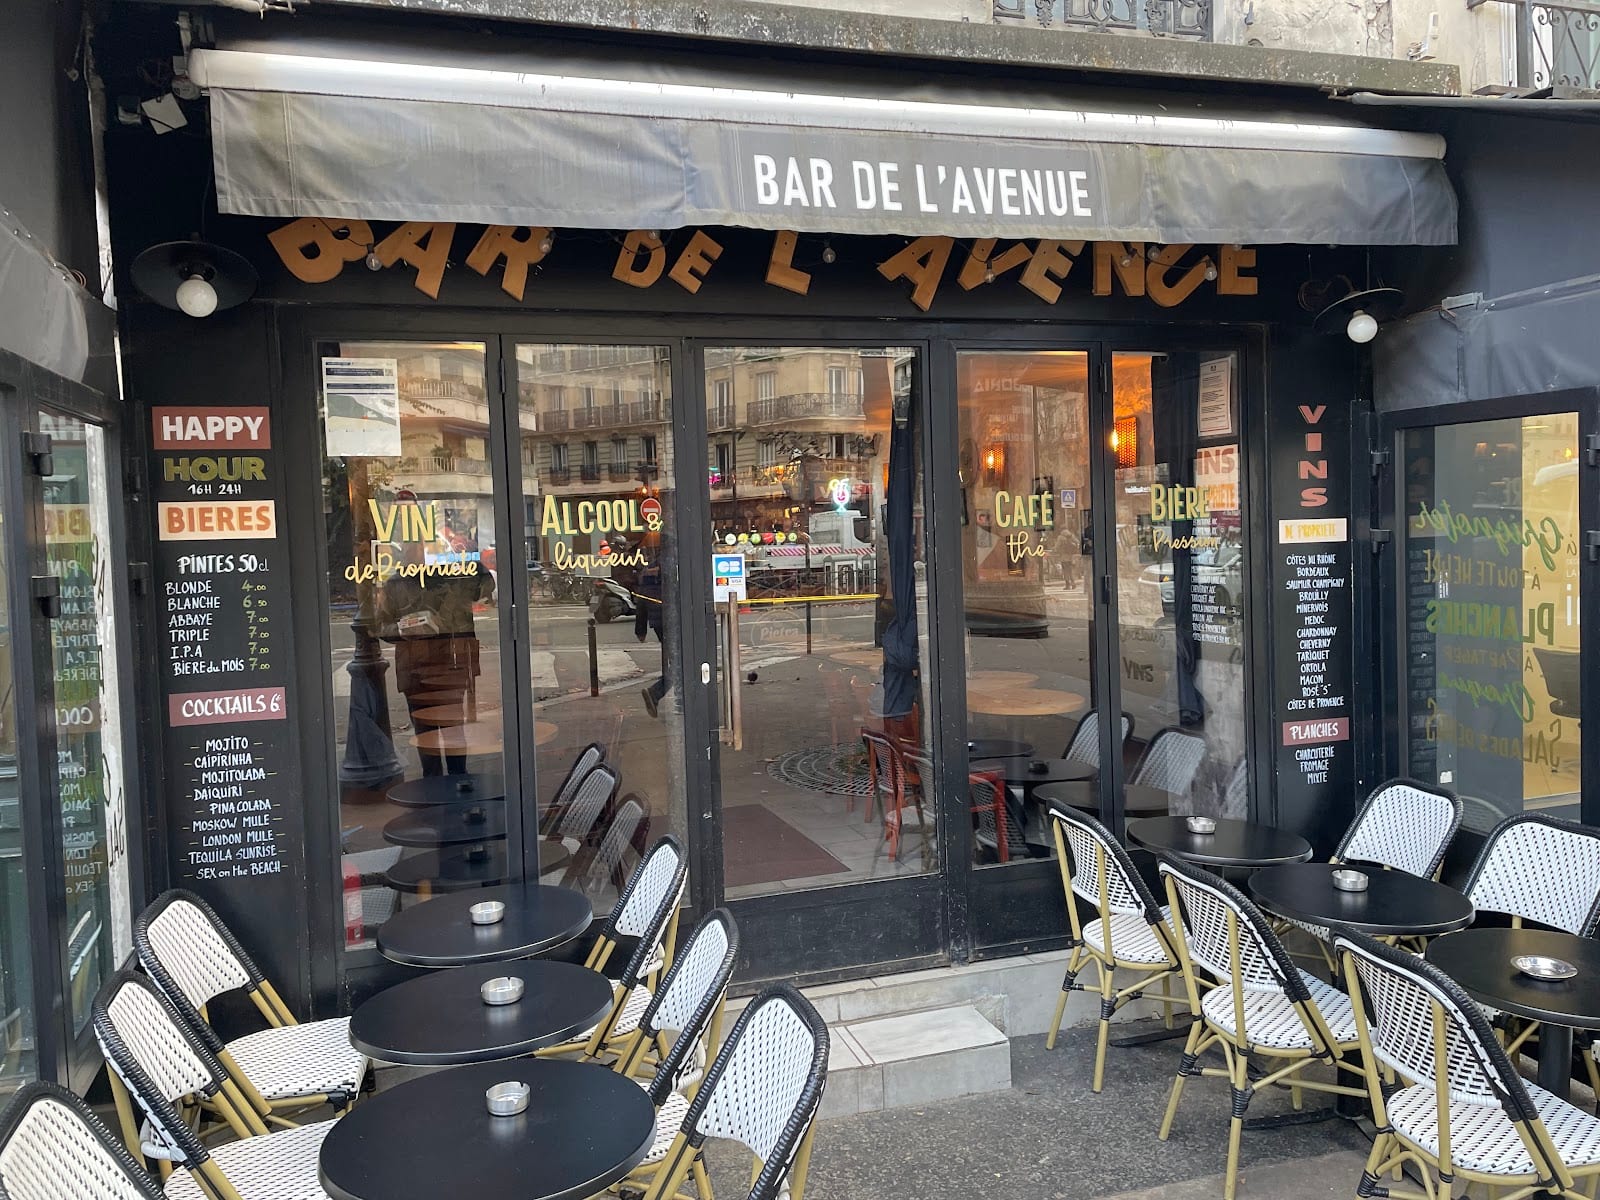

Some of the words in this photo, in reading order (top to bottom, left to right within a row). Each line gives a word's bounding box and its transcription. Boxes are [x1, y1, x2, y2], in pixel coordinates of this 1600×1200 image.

[754, 154, 837, 209] BAR
[852, 160, 903, 212] DE
[915, 163, 1093, 217] L'AVENUE
[267, 216, 554, 302] BAR
[612, 229, 725, 295] DE
[162, 415, 265, 441] HAPPY
[1298, 405, 1329, 508] VINS
[163, 456, 267, 482] HOUR
[187, 484, 213, 495] 16H
[218, 484, 242, 495] 24H
[541, 494, 644, 537] ALCOOL
[647, 512, 663, 533] &
[995, 490, 1054, 528] CAFÉ
[167, 505, 271, 534] BIERES
[368, 498, 437, 543] VIN
[177, 554, 235, 575] PINTES
[237, 554, 258, 573] 50
[554, 543, 649, 575] liqueur
[1296, 566, 1330, 577] BORDEAUX
[165, 580, 213, 596] BLONDE
[1299, 589, 1329, 602] BROUILLY
[167, 596, 221, 612] BLANCHE
[1296, 602, 1329, 614] MINERVOIS
[168, 613, 213, 628] ABBAYE
[1304, 615, 1325, 625] MEDOC
[169, 628, 211, 643] TRIPLE
[1296, 626, 1337, 639] CHARDONNAY
[1299, 638, 1332, 650] CHEVERNY
[1296, 650, 1331, 661] TARIQUET
[206, 661, 221, 674] du
[222, 658, 245, 673] MOIS
[1300, 674, 1324, 686] MACON
[182, 693, 266, 718] COCKTAILS
[1308, 698, 1316, 709] DE
[1316, 696, 1345, 709] PROVENCE
[1289, 722, 1339, 740] PLANCHES
[205, 735, 249, 753] MOJITO
[194, 752, 253, 769] CAIPIRINHA
[1295, 745, 1335, 761] CHARCUTERIE
[1300, 758, 1330, 773] FROMAGE
[202, 766, 266, 785] MOJITOLADA
[1307, 771, 1328, 785] MIXTE
[193, 783, 243, 801] DAIQUIRI
[209, 801, 236, 815] PINA
[236, 798, 272, 814] COLADA
[192, 817, 237, 833] MOSKOW
[242, 813, 270, 828] MULE
[202, 832, 242, 847] LONDON
[246, 829, 274, 843] MULE
[188, 848, 233, 865] TEQUILA
[235, 843, 278, 860] SUNRISE
[196, 867, 217, 880] SEX
[218, 869, 230, 878] on
[249, 860, 281, 876] BEACH
